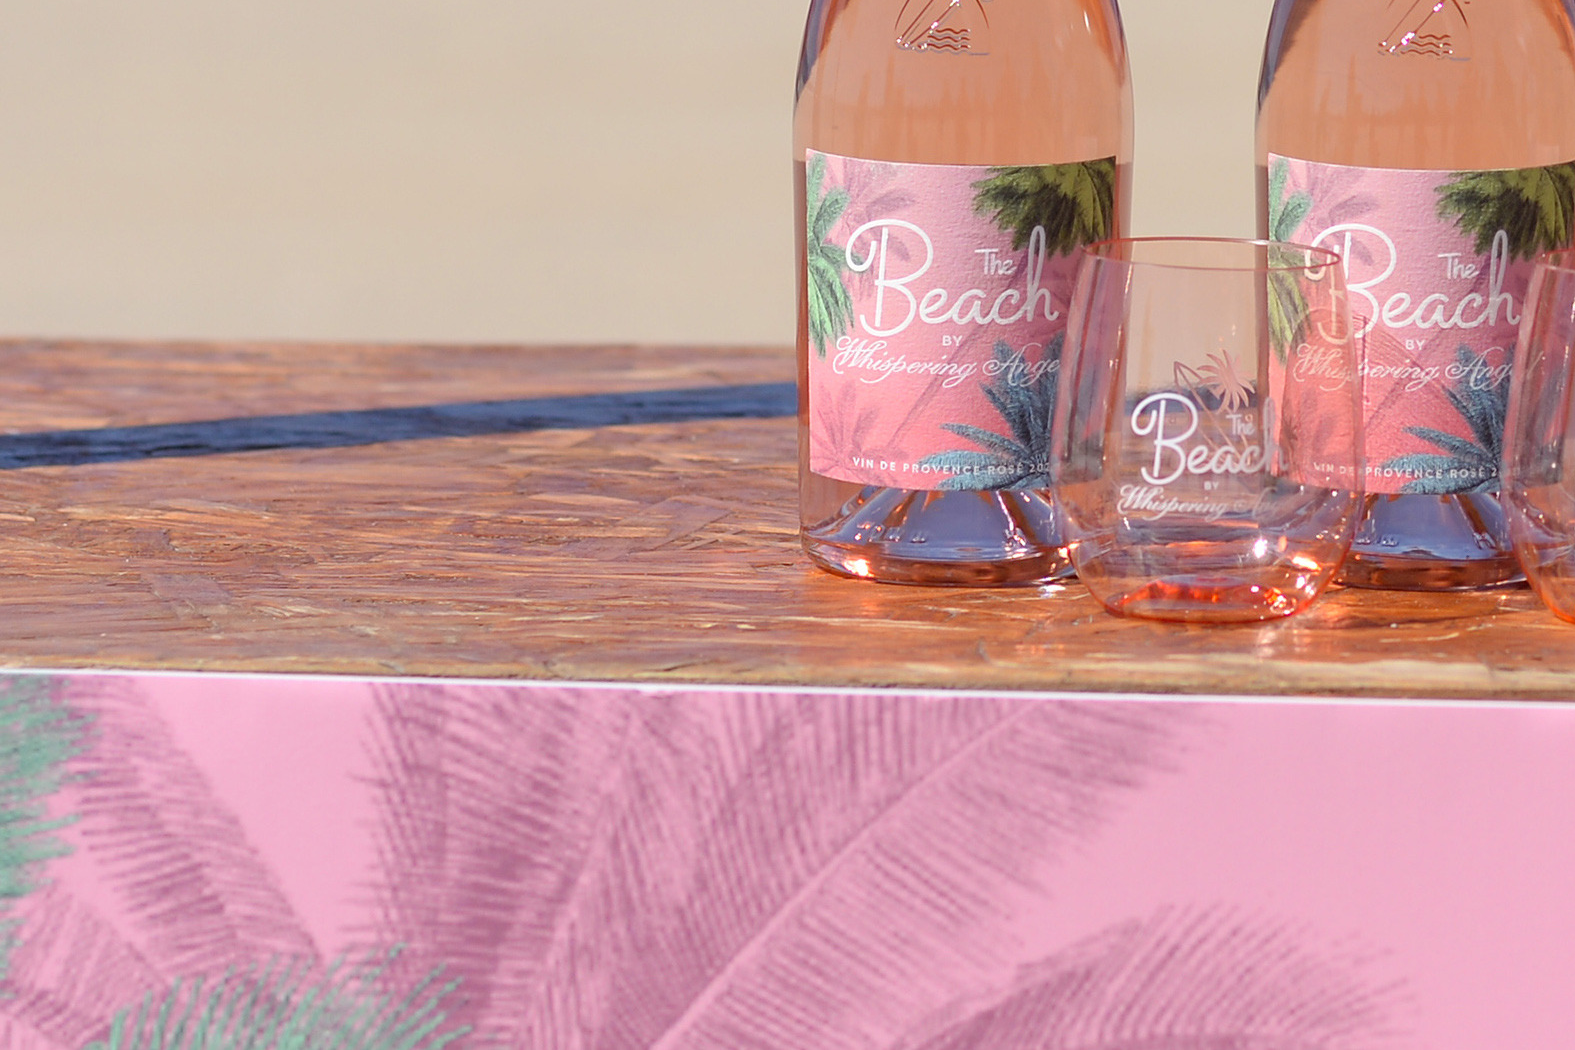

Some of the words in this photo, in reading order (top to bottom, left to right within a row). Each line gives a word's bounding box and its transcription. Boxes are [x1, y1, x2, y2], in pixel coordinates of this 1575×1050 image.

[974, 249, 1018, 276] The
[1437, 253, 1480, 280] The
[845, 218, 1060, 337] Beach
[1304, 223, 1521, 344] Beach
[942, 335, 963, 347] BY
[1405, 340, 1426, 351] BY
[833, 336, 978, 388] Whispering
[982, 343, 1061, 388] Ange
[1445, 346, 1513, 390] Ang
[1131, 392, 1288, 485] Beach
[1225, 414, 1256, 436] The
[852, 457, 874, 469] VIN
[880, 460, 896, 471] DE
[903, 463, 981, 475] PROVENCE
[988, 461, 1023, 475] ROSÉ
[1339, 466, 1354, 476] DE
[1365, 467, 1443, 479] PROVENCE
[1450, 466, 1485, 479] ROSÉ
[1204, 481, 1220, 490] BY
[1117, 484, 1230, 523] Whispering
